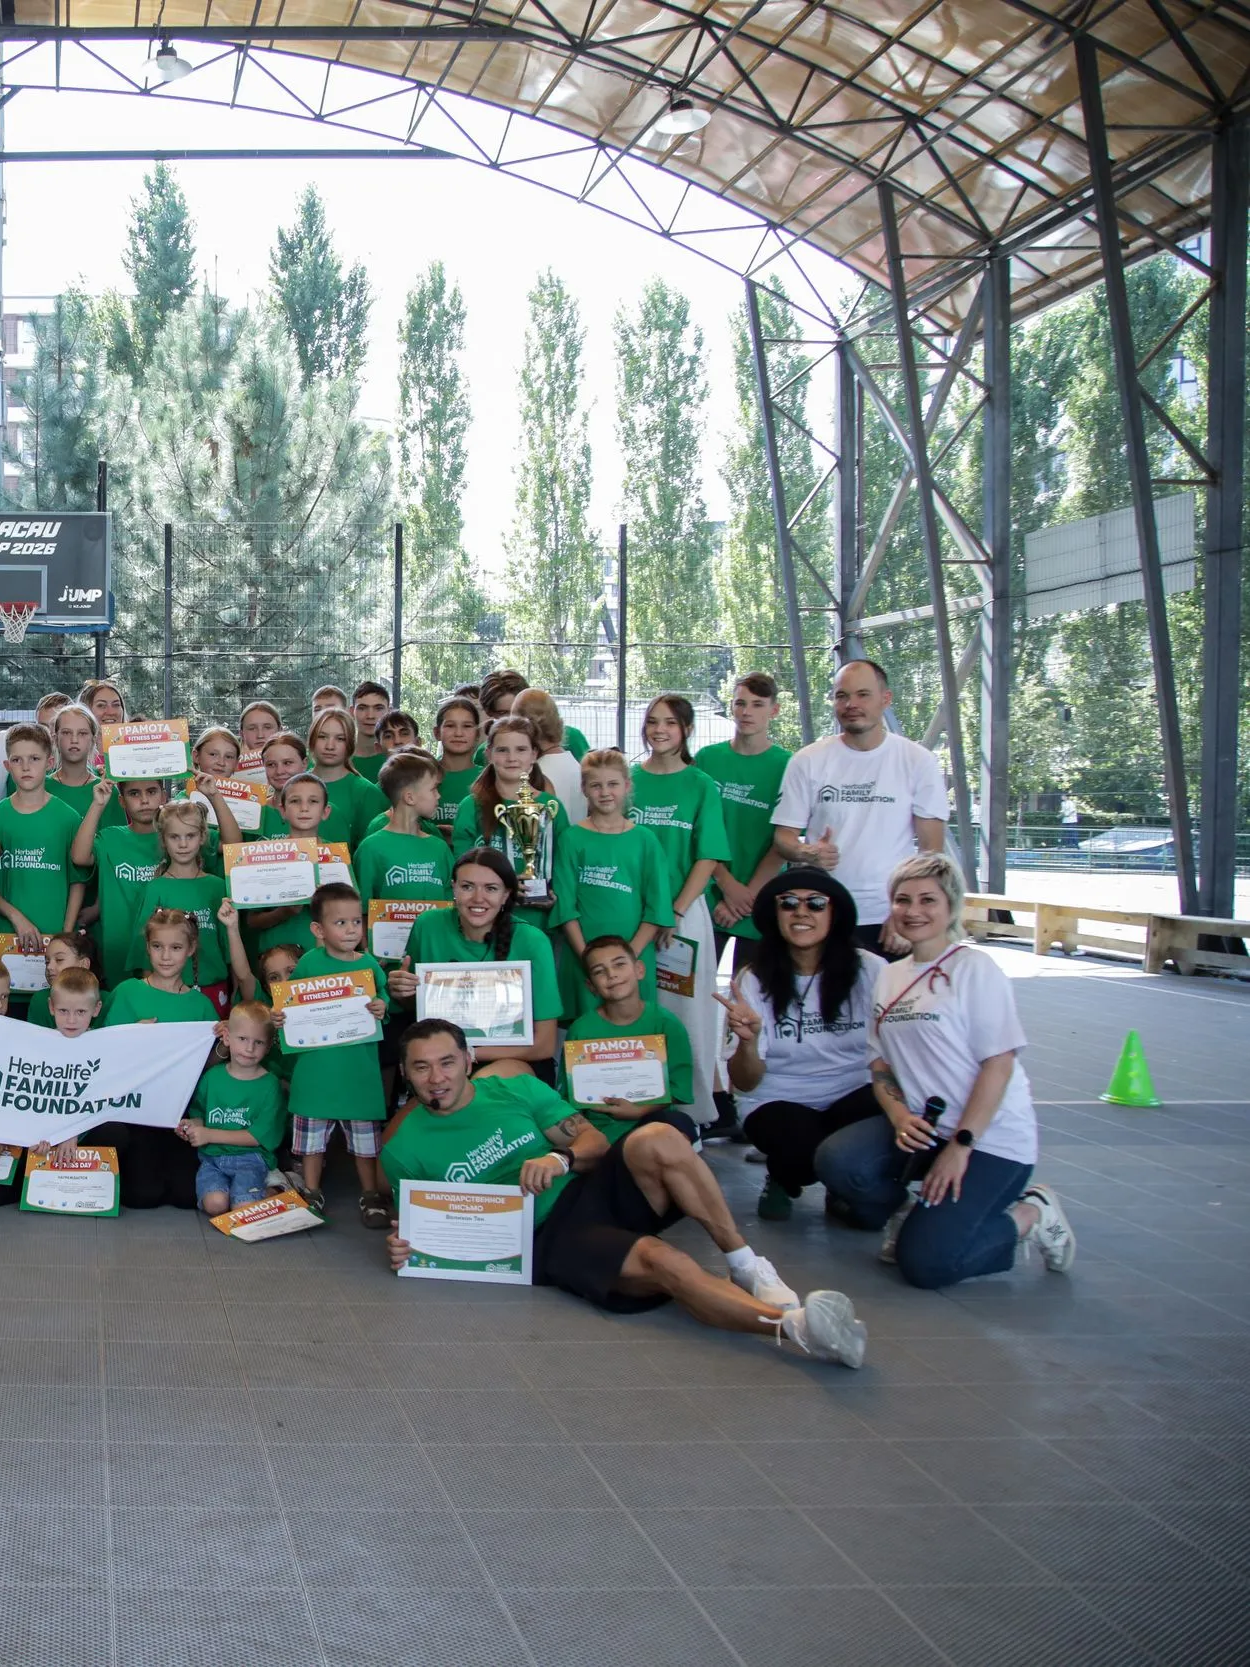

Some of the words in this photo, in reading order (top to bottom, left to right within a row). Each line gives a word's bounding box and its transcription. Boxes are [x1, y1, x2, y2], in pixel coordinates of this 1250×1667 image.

[10, 542, 57, 555] 2026
[118, 724, 171, 736] ГРАМОТА
[239, 751, 263, 763] РАМО
[215, 779, 251, 793] АМОТА
[644, 819, 693, 830] FOUNDATION
[241, 841, 298, 856] ГРАМОТА
[251, 854, 276, 862] FITNESS
[276, 853, 290, 861] DAY
[15, 862, 60, 871] FOUNDATION
[584, 872, 614, 881] FAMILY
[583, 878, 633, 893] FOUNDATION
[290, 976, 353, 995] ГРАМОТА
[303, 992, 330, 1002] FITNESS
[330, 989, 344, 998] DAY
[583, 1040, 645, 1053] ГРАМОТА
[8, 1056, 91, 1081] Herbalife
[5, 1074, 88, 1097] FAMILY
[1, 1092, 142, 1114] FOUNDATON
[466, 1132, 501, 1160] Herbalife
[470, 1140, 504, 1166] FAMILY
[475, 1132, 536, 1174] FOUNDATION
[229, 1199, 285, 1222] ГРАМОТА
